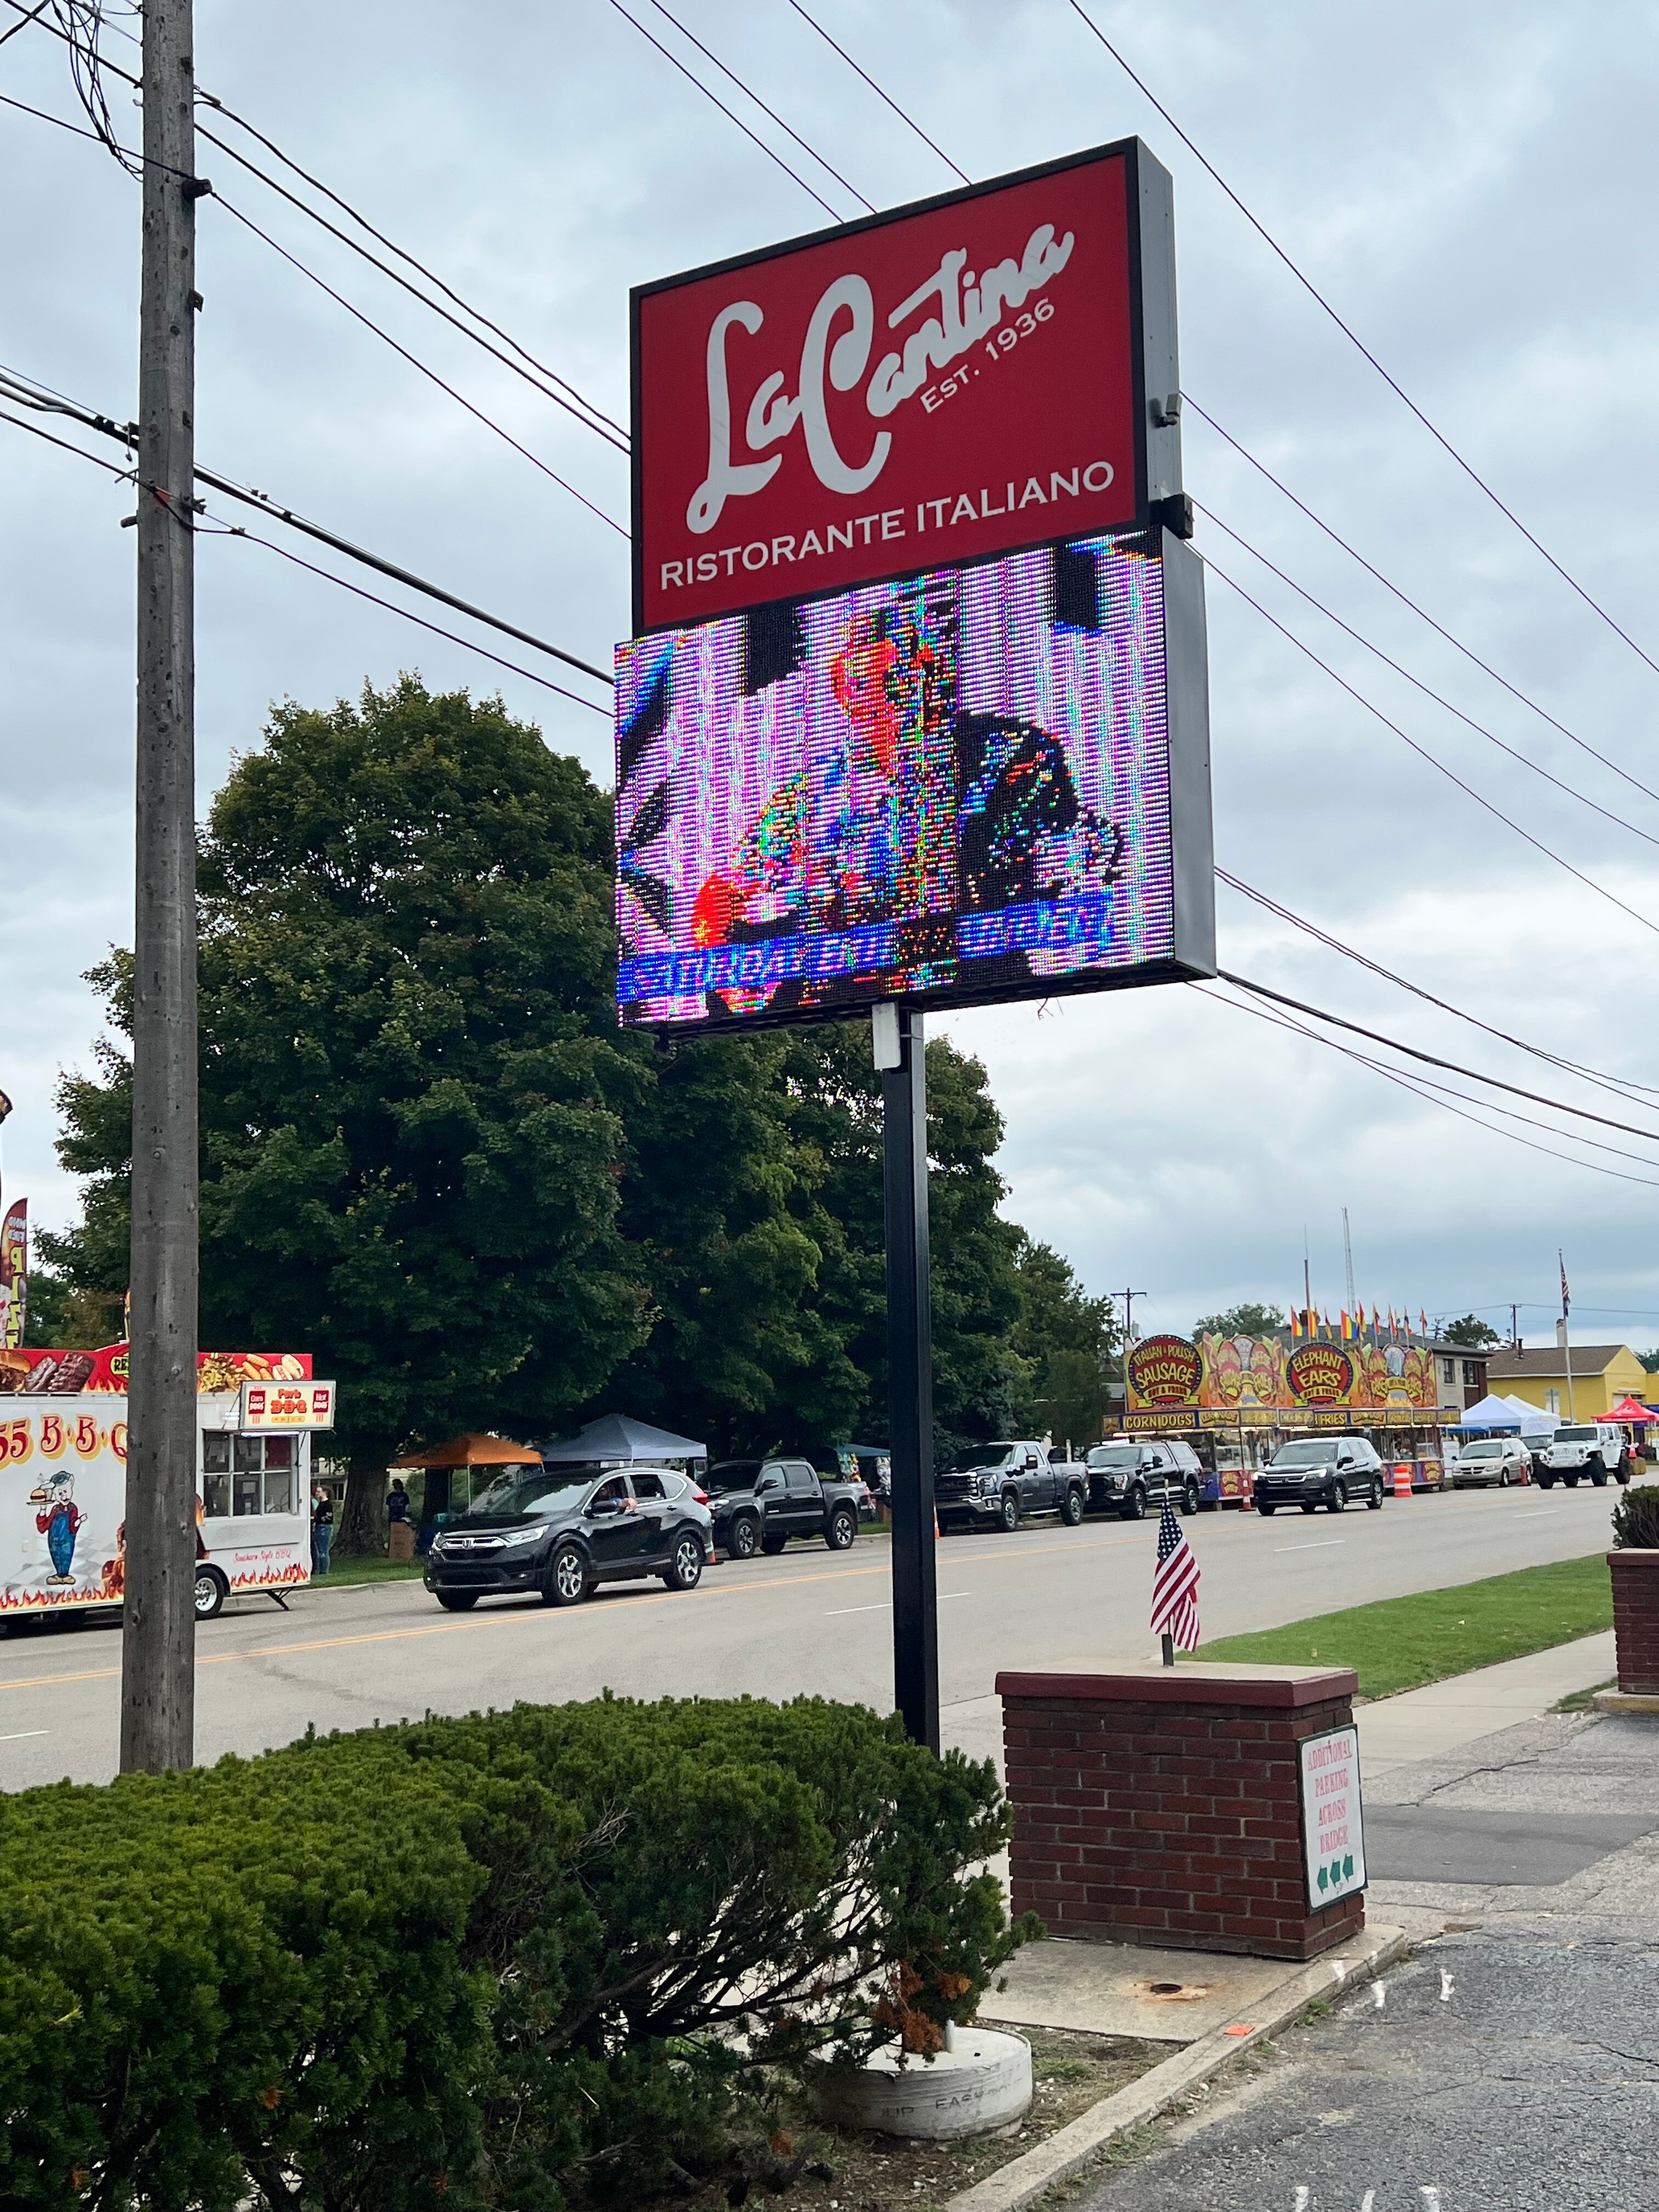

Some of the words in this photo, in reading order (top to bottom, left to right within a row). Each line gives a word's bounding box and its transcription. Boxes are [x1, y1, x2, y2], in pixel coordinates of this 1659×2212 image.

[920, 365, 980, 414] EST.
[986, 297, 1056, 360] 1936
[686, 301, 802, 535] La
[798, 223, 1075, 494] Cantina
[661, 509, 905, 590] RISTORANTE
[917, 461, 1114, 532] ITALIANO
[1133, 1345, 1163, 1366] ITALIAN
[1167, 1345, 1196, 1363] POLISH
[1292, 1350, 1345, 1373] ELEPHANT
[1136, 1362, 1195, 1389] SAUSAGE
[1299, 1370, 1341, 1388] EARS
[1126, 1415, 1158, 1429] CORN
[1161, 1413, 1193, 1426] DOGS
[1319, 1413, 1345, 1425] FRIES
[1307, 1739, 1352, 1771] ADDITIONAL
[1315, 1768, 1349, 1798] PARKING
[1318, 1798, 1346, 1827] ACROSS
[1319, 1825, 1349, 1854] BRIDGE
